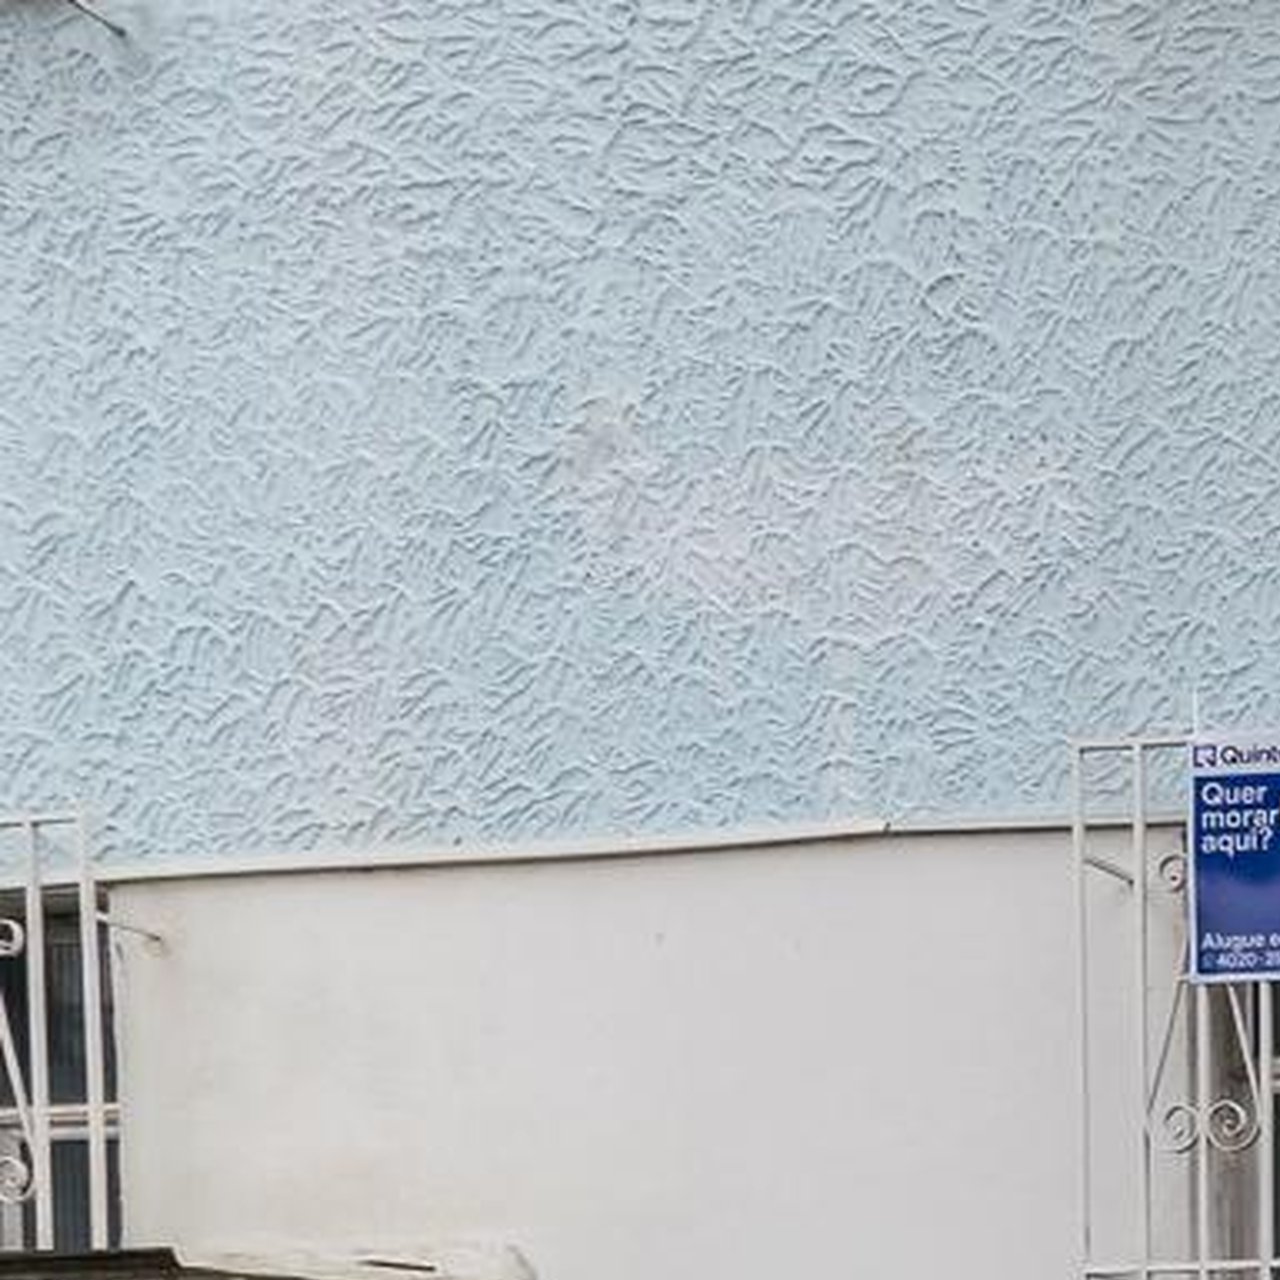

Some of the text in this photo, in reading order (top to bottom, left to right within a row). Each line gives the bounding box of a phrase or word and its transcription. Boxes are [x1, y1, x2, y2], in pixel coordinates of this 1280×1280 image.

[1202, 782, 1268, 805] Quer
[1202, 809, 1278, 830] morar
[1201, 826, 1274, 859] aqui?
[1203, 933, 1266, 953] Alugue
